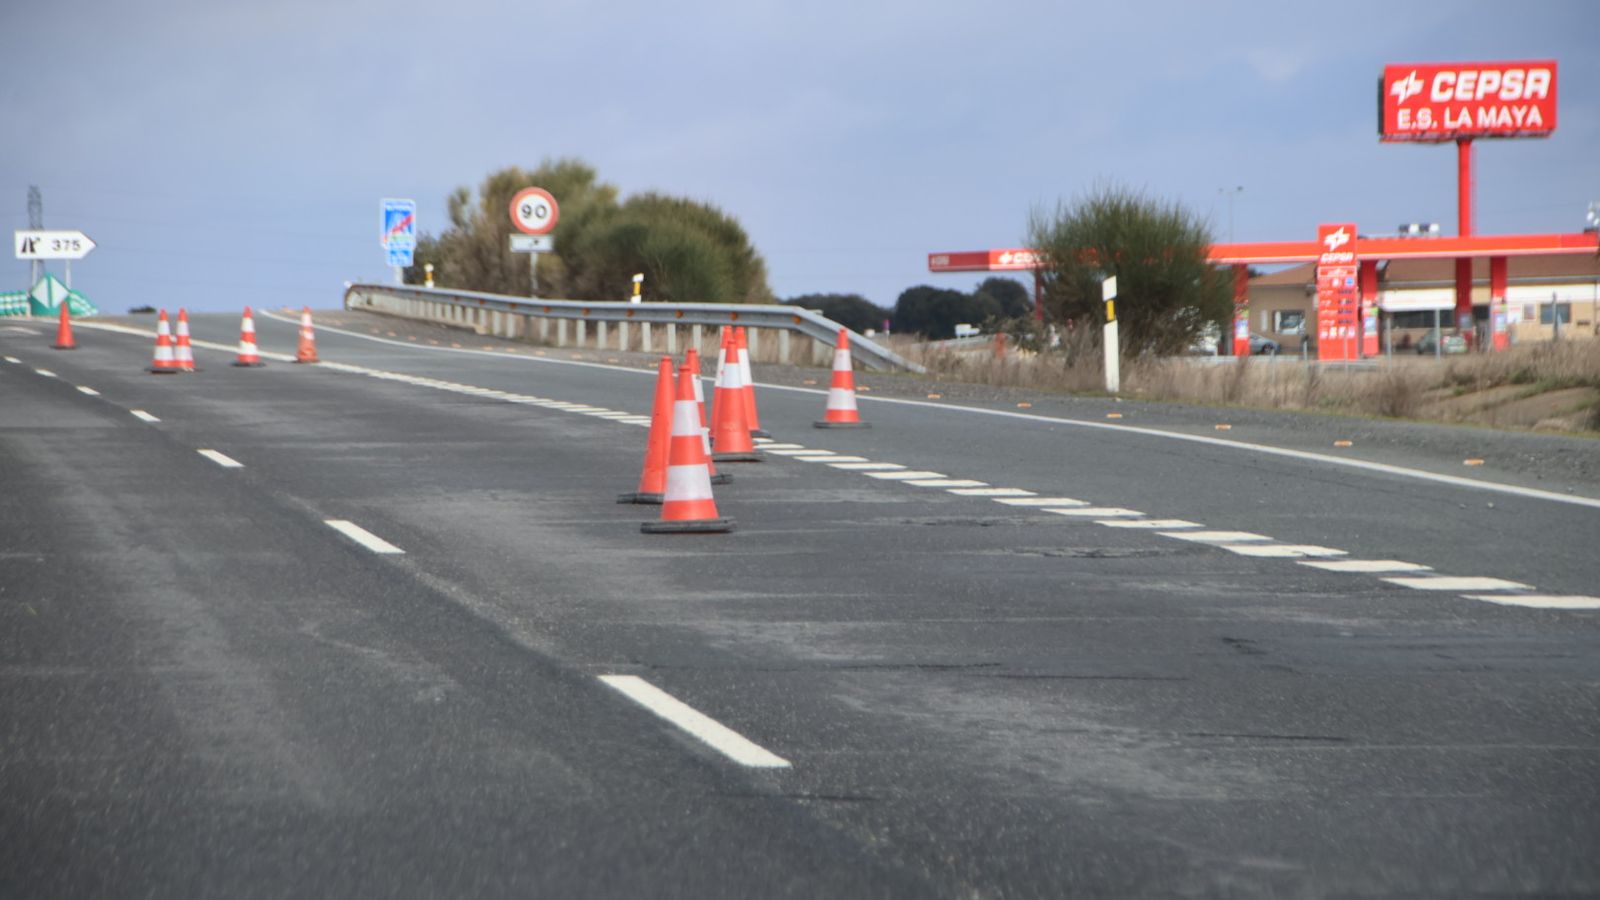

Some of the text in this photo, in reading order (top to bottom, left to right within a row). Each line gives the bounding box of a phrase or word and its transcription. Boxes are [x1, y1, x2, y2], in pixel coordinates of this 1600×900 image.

[1430, 69, 1552, 102] CEPSA
[1397, 104, 1543, 130] E.S. LA MAYA
[521, 204, 548, 219] 90
[51, 239, 82, 252] 375
[1320, 252, 1354, 264] CEPSA
